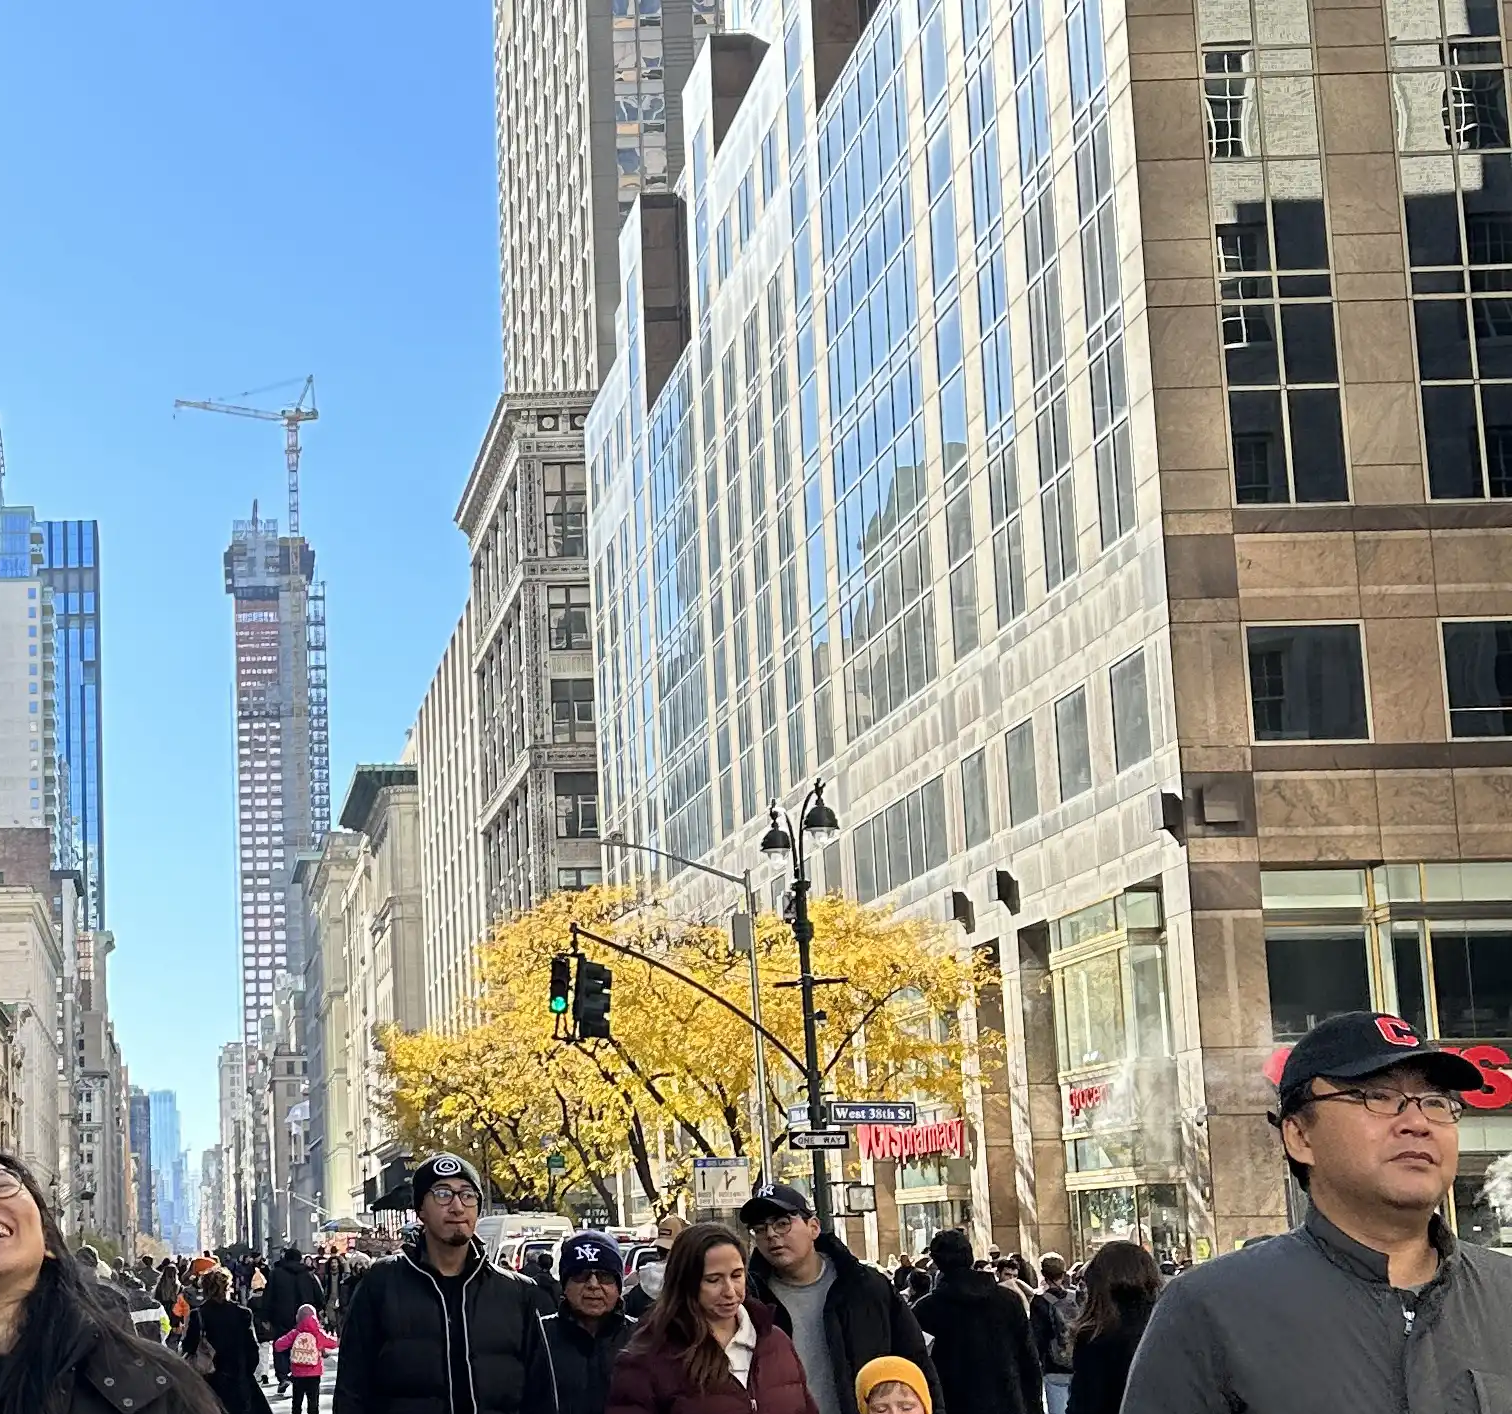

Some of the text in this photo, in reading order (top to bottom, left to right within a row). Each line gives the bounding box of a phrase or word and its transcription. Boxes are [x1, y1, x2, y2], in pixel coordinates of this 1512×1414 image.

[1374, 1016, 1420, 1047] C
[1069, 1083, 1110, 1118] grocer
[835, 1107, 911, 1120] West 38th St
[798, 1136, 842, 1145] ONE WAY
[574, 1243, 601, 1262] NY
